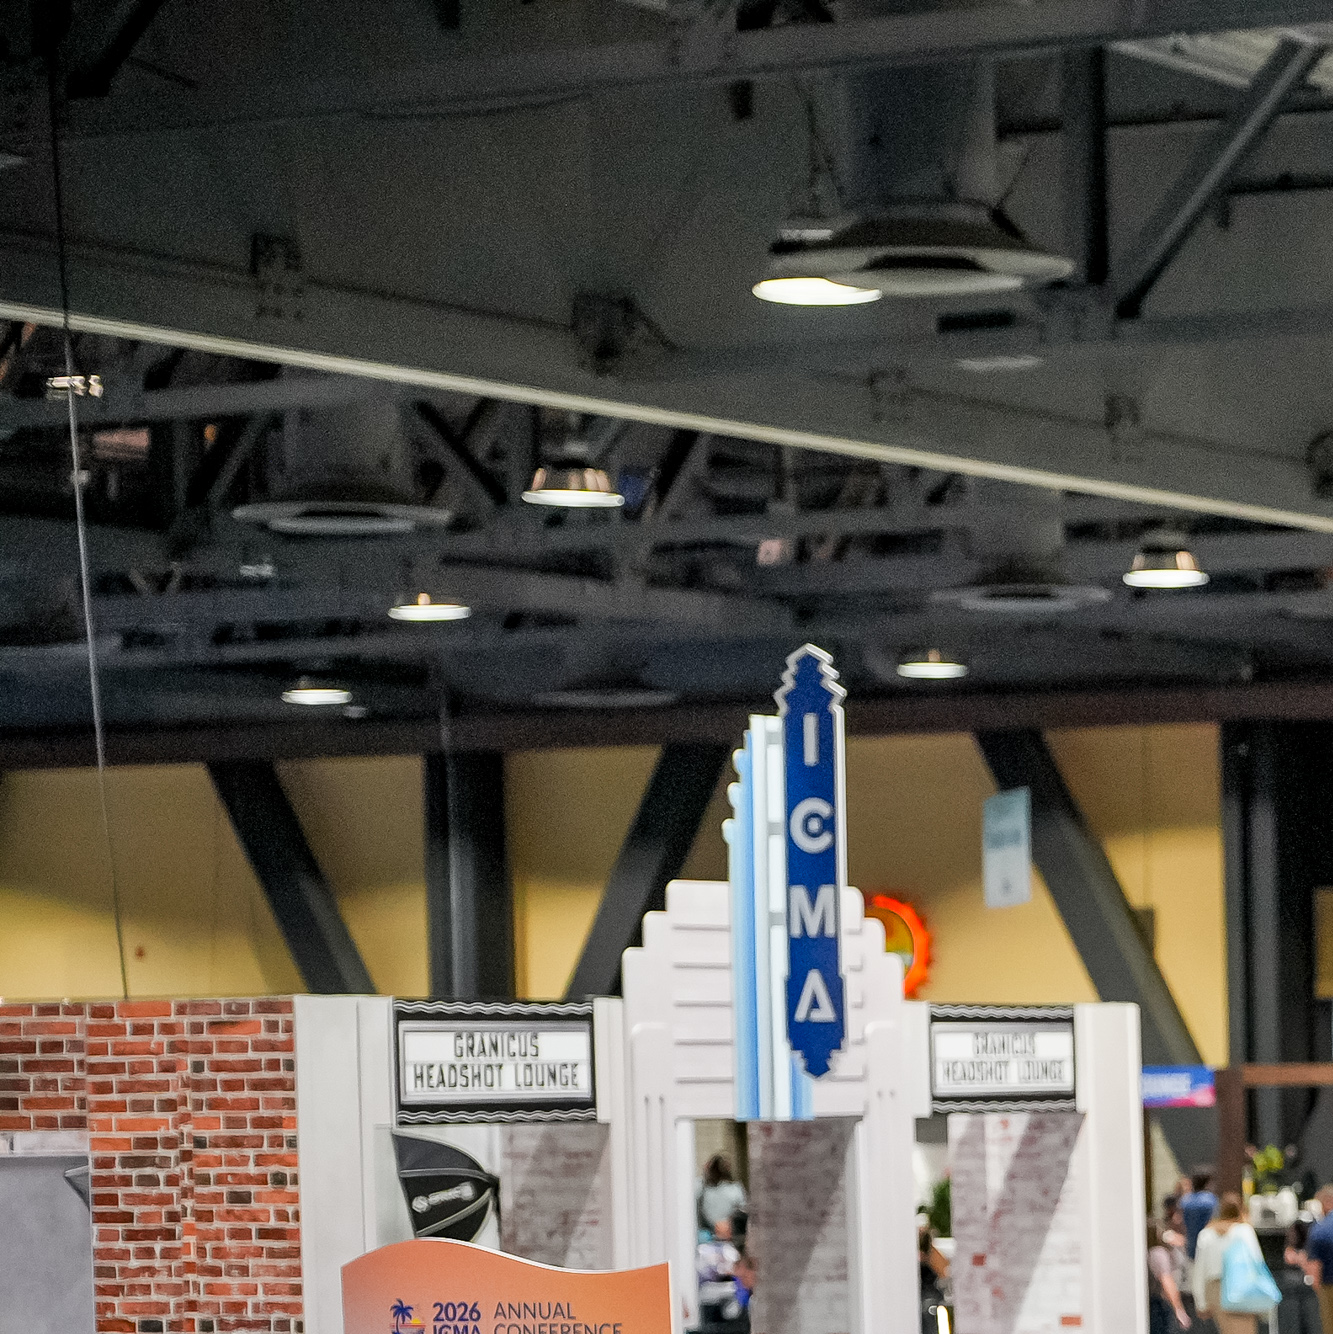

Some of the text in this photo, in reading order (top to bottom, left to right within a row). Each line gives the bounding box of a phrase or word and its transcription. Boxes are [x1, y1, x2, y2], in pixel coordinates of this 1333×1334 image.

[790, 712, 837, 1022] ICMA
[454, 1032, 539, 1058] GRANICUS
[413, 1063, 580, 1089] HEADSHOT LOUNGE
[432, 1302, 576, 1322] 2026 ANNUAL
